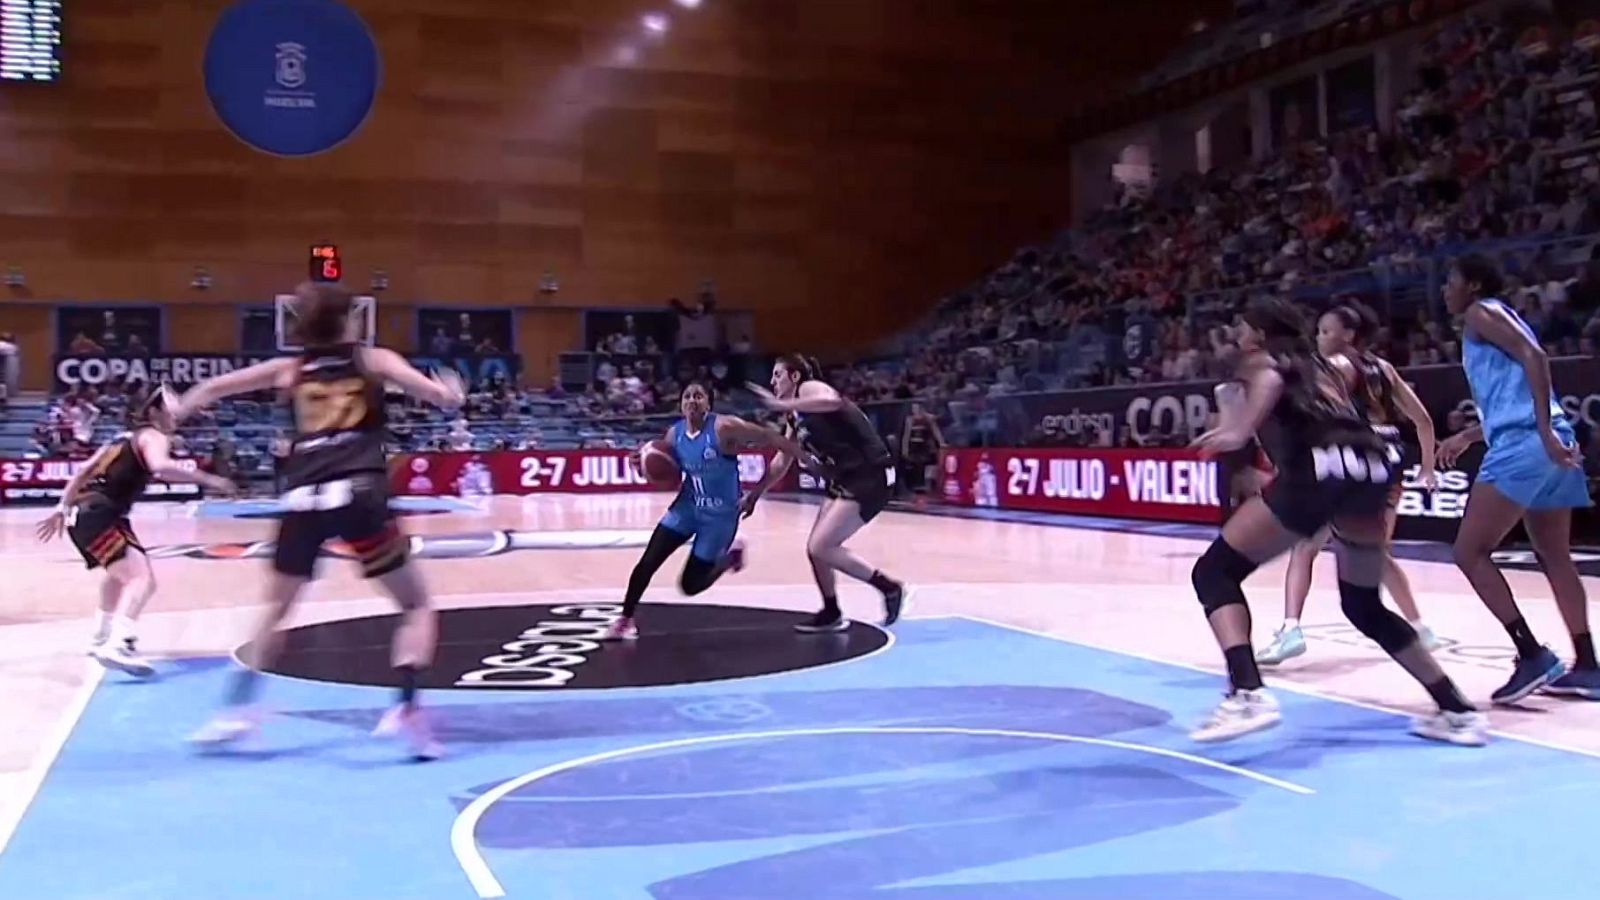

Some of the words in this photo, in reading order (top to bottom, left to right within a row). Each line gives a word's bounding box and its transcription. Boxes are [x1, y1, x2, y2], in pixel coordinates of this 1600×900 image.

[57, 358, 149, 384] COPA
[1126, 396, 1210, 446] COP
[520, 456, 567, 487] 2-7
[1007, 457, 1040, 496] 2-7
[1043, 459, 1105, 500] JULIO
[453, 604, 624, 686] endesa
